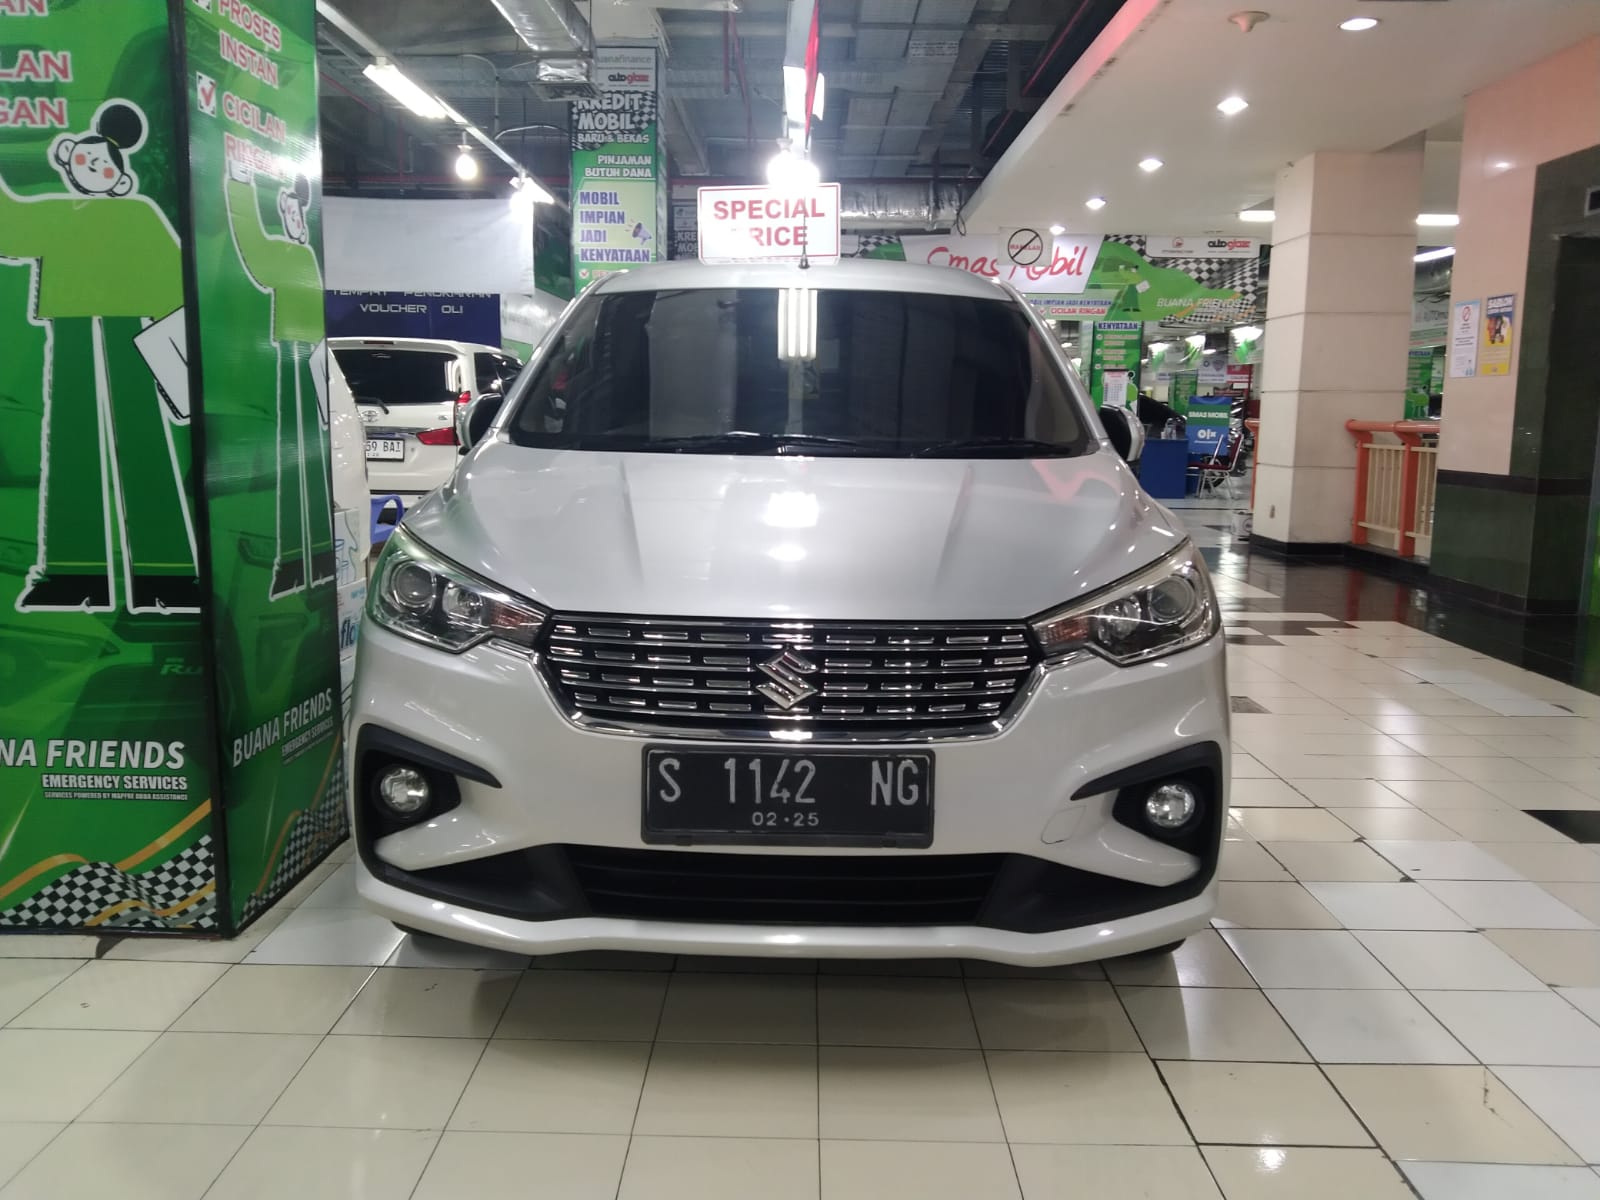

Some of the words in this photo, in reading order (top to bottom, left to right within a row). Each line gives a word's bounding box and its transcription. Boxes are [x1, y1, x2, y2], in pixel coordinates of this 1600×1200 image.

[219, 0, 281, 50] PROSES
[220, 31, 278, 88] INSTAN
[223, 93, 286, 143] CICILAN
[578, 113, 635, 130] MOBIL
[578, 134, 604, 143] BARU
[617, 134, 649, 143] BEKAS
[598, 155, 652, 165] PINJAMAN
[585, 168, 620, 177] BUTUH
[622, 168, 652, 177] DANA
[580, 192, 620, 206] MOBIL
[713, 198, 826, 220] SPECIAL
[580, 211, 626, 224] IMPIAN
[580, 230, 607, 243] JADI
[581, 249, 650, 262] KENYATAAN
[360, 303, 427, 314] VOUCHER
[441, 305, 463, 314] OLI
[232, 716, 281, 769] BUANA
[283, 687, 333, 738] FRIENDS
[46, 739, 185, 770] FRIENDS
[42, 774, 119, 788] EMERGENCY
[123, 776, 188, 790] SERVICES
[659, 758, 681, 802] S
[724, 757, 816, 804] 1142
[870, 759, 919, 806] NG
